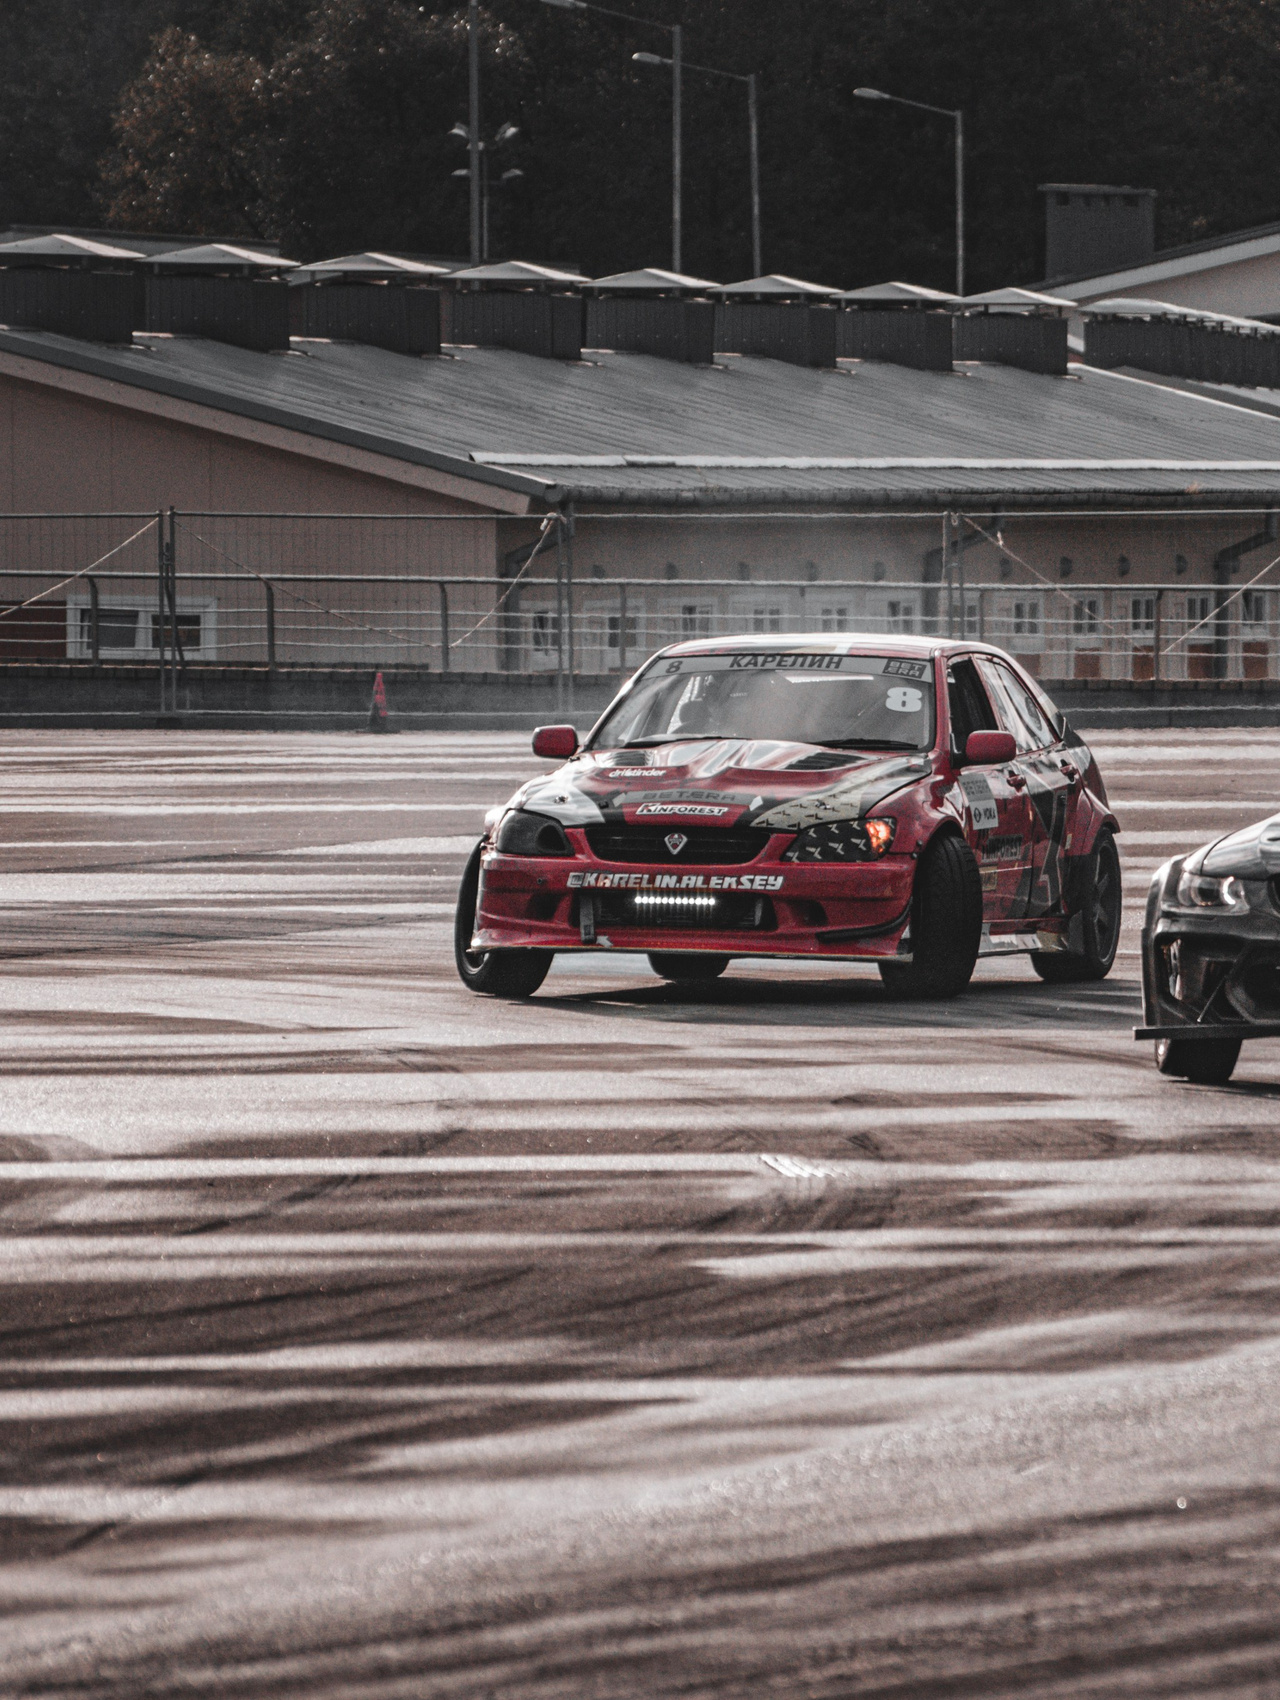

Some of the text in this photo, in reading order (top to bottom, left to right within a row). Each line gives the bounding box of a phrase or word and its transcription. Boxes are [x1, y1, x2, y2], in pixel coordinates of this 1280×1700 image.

[664, 660, 684, 674] 8
[729, 654, 844, 669] КАРЕЛИН
[885, 686, 923, 713] 8
[566, 872, 785, 890] @KARELIN.ALEKSEY
